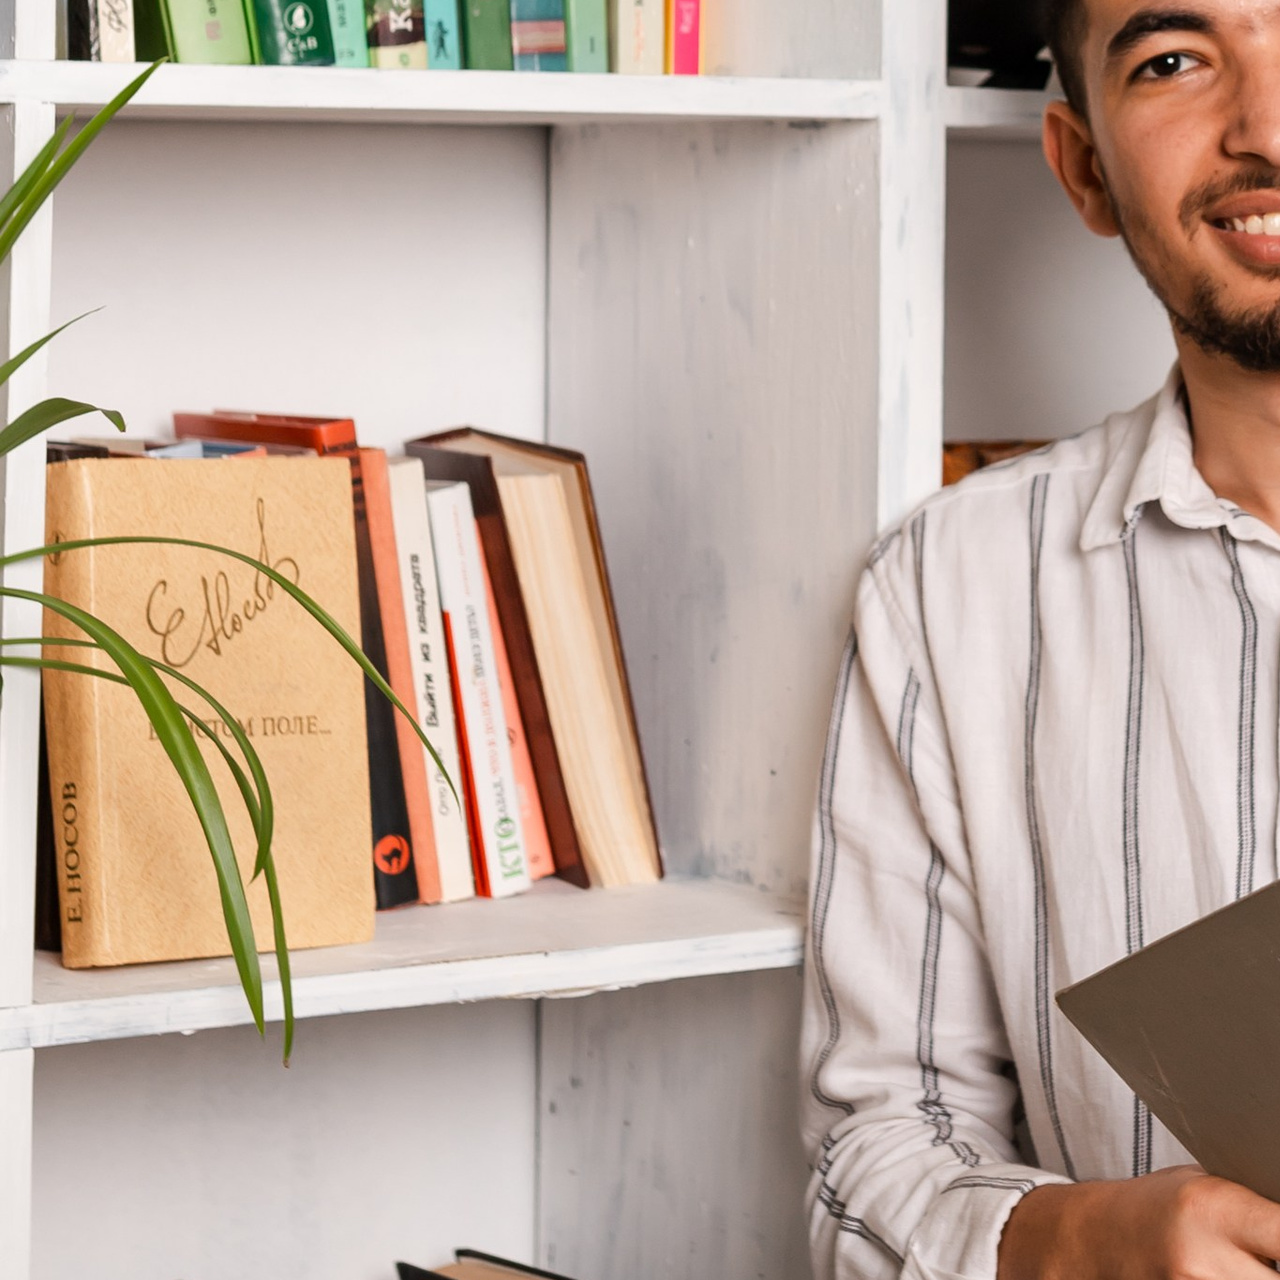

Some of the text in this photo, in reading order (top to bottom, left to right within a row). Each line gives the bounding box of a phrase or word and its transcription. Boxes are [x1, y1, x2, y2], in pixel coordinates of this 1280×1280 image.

[409, 552, 439, 729] Выйти из квадрата
[494, 816, 525, 880] КТО
